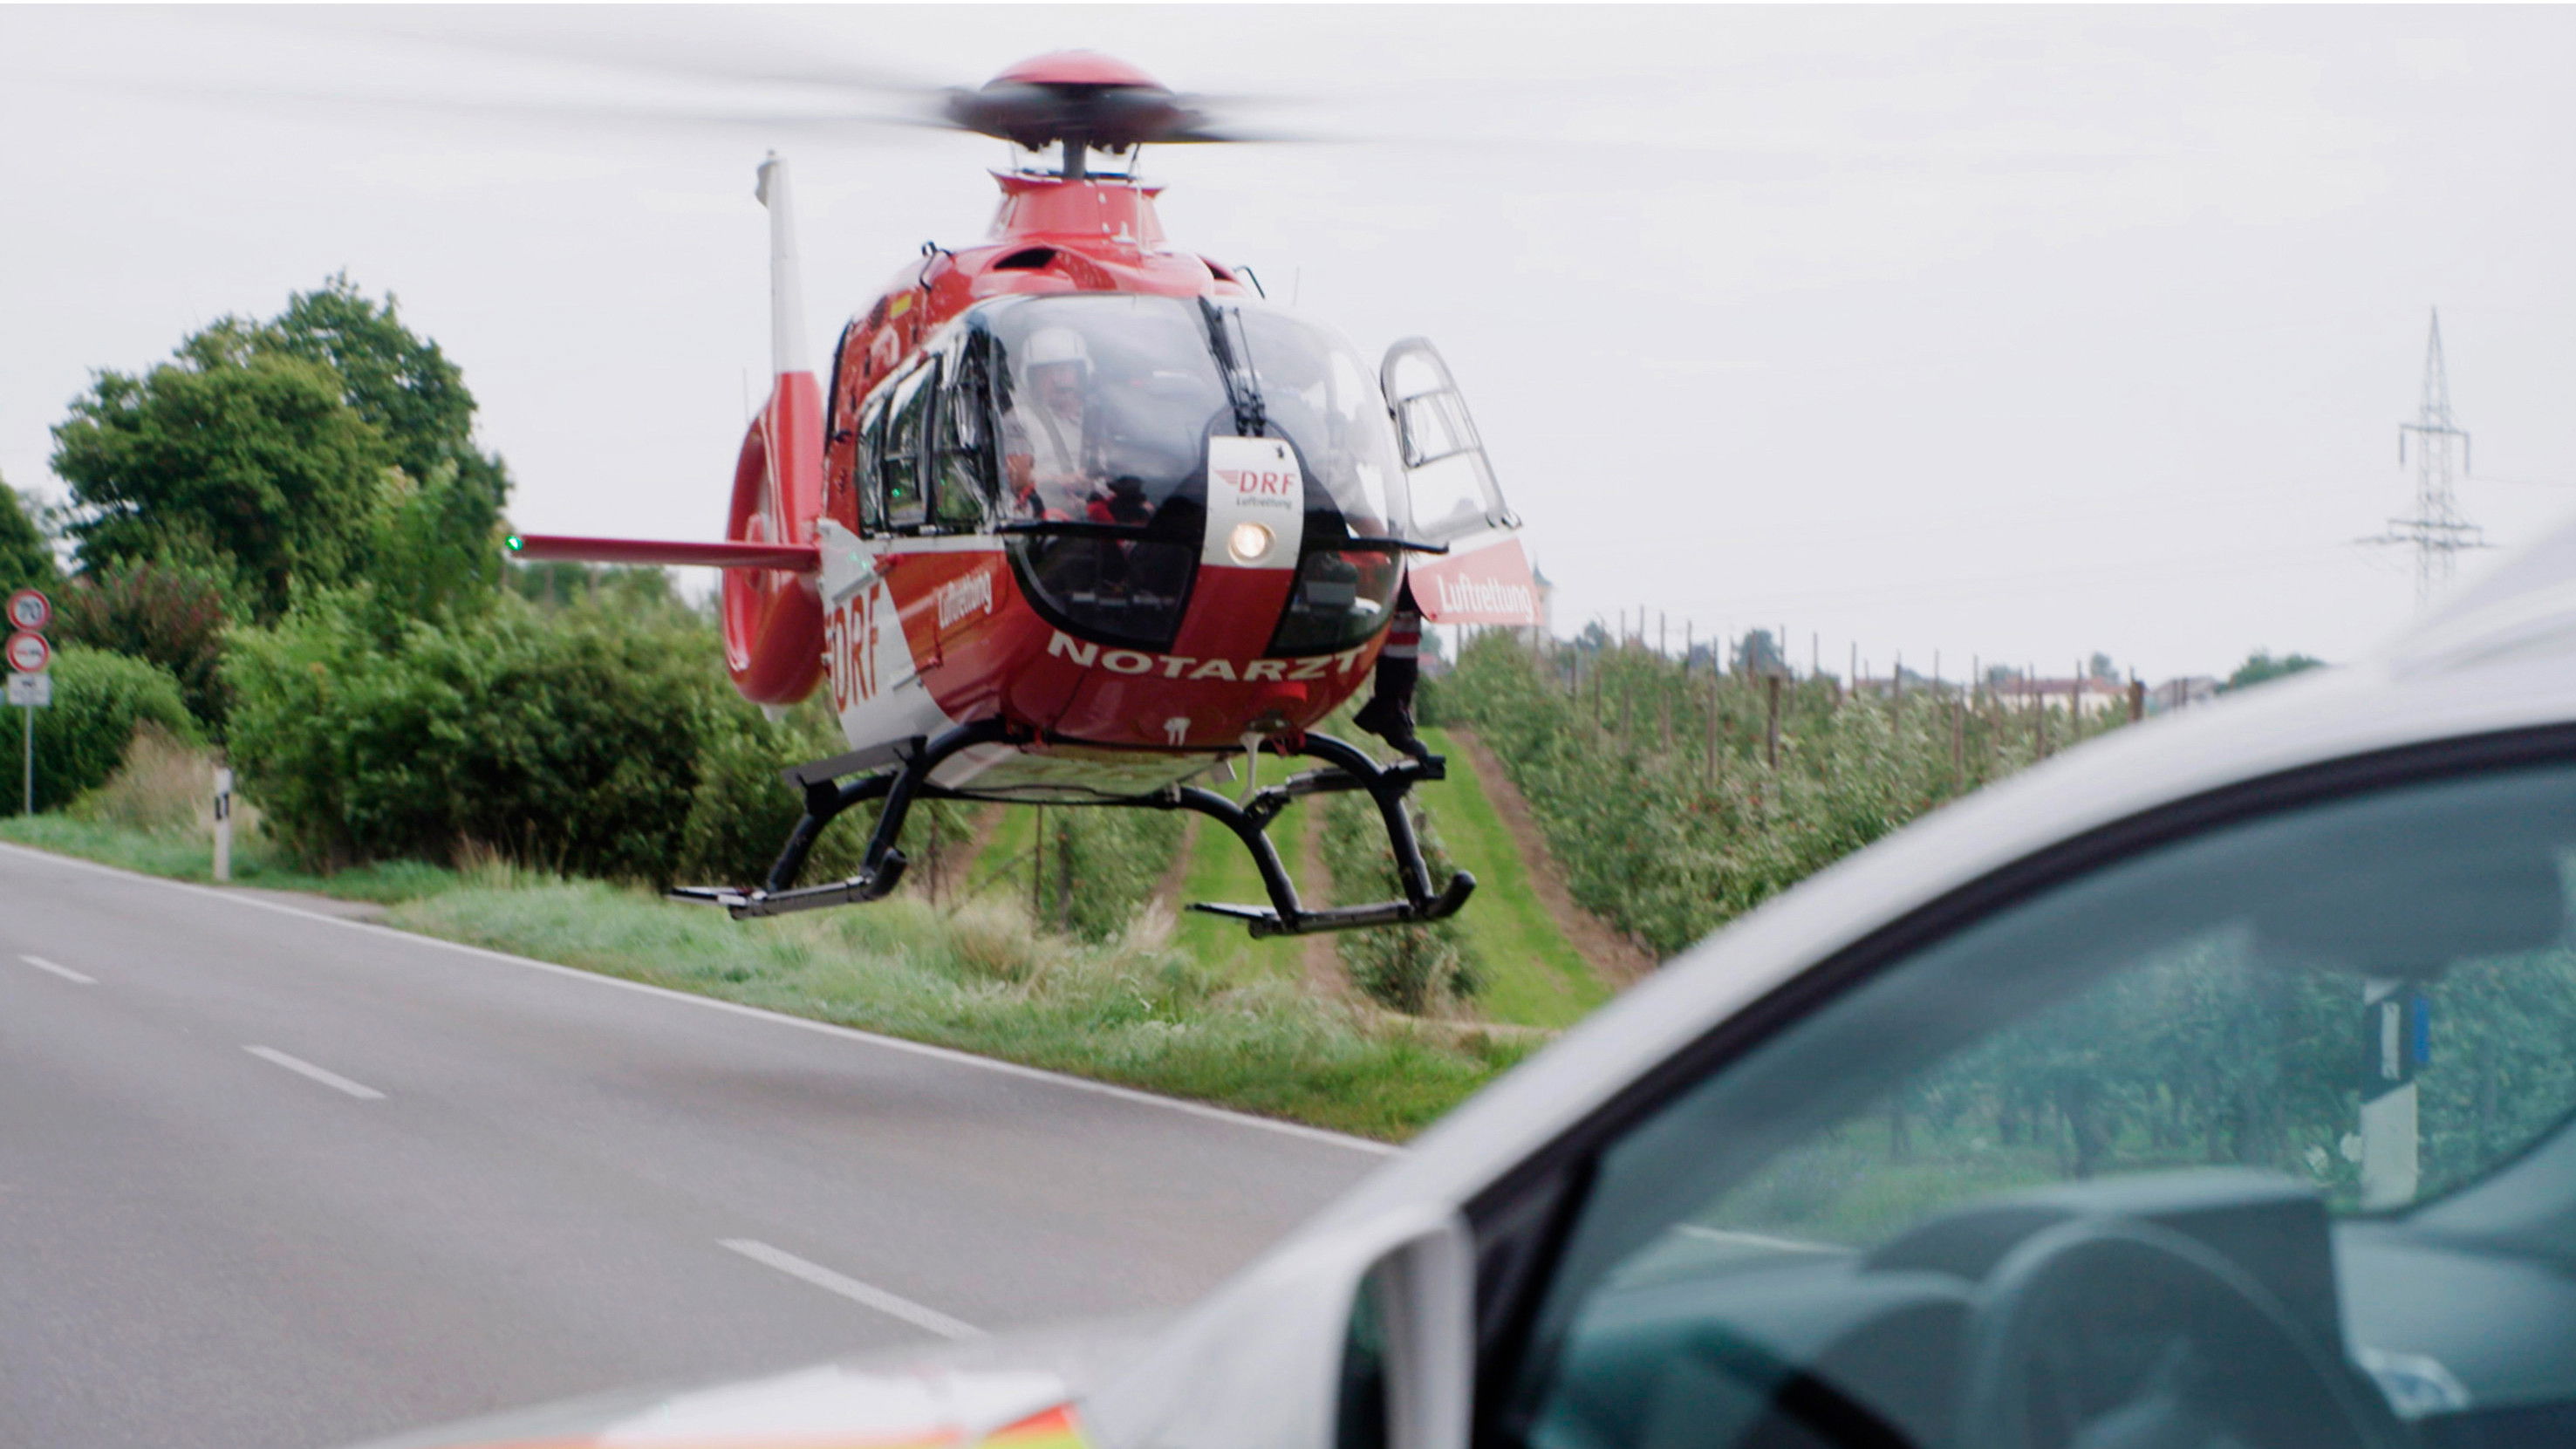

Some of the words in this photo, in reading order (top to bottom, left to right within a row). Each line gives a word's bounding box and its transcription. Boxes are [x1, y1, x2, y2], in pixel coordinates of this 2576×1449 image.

[1240, 471, 1295, 496] DRF
[1437, 572, 1534, 623] Luftrettung
[833, 582, 881, 712] DRF
[1048, 631, 1368, 681] NOTARZT
